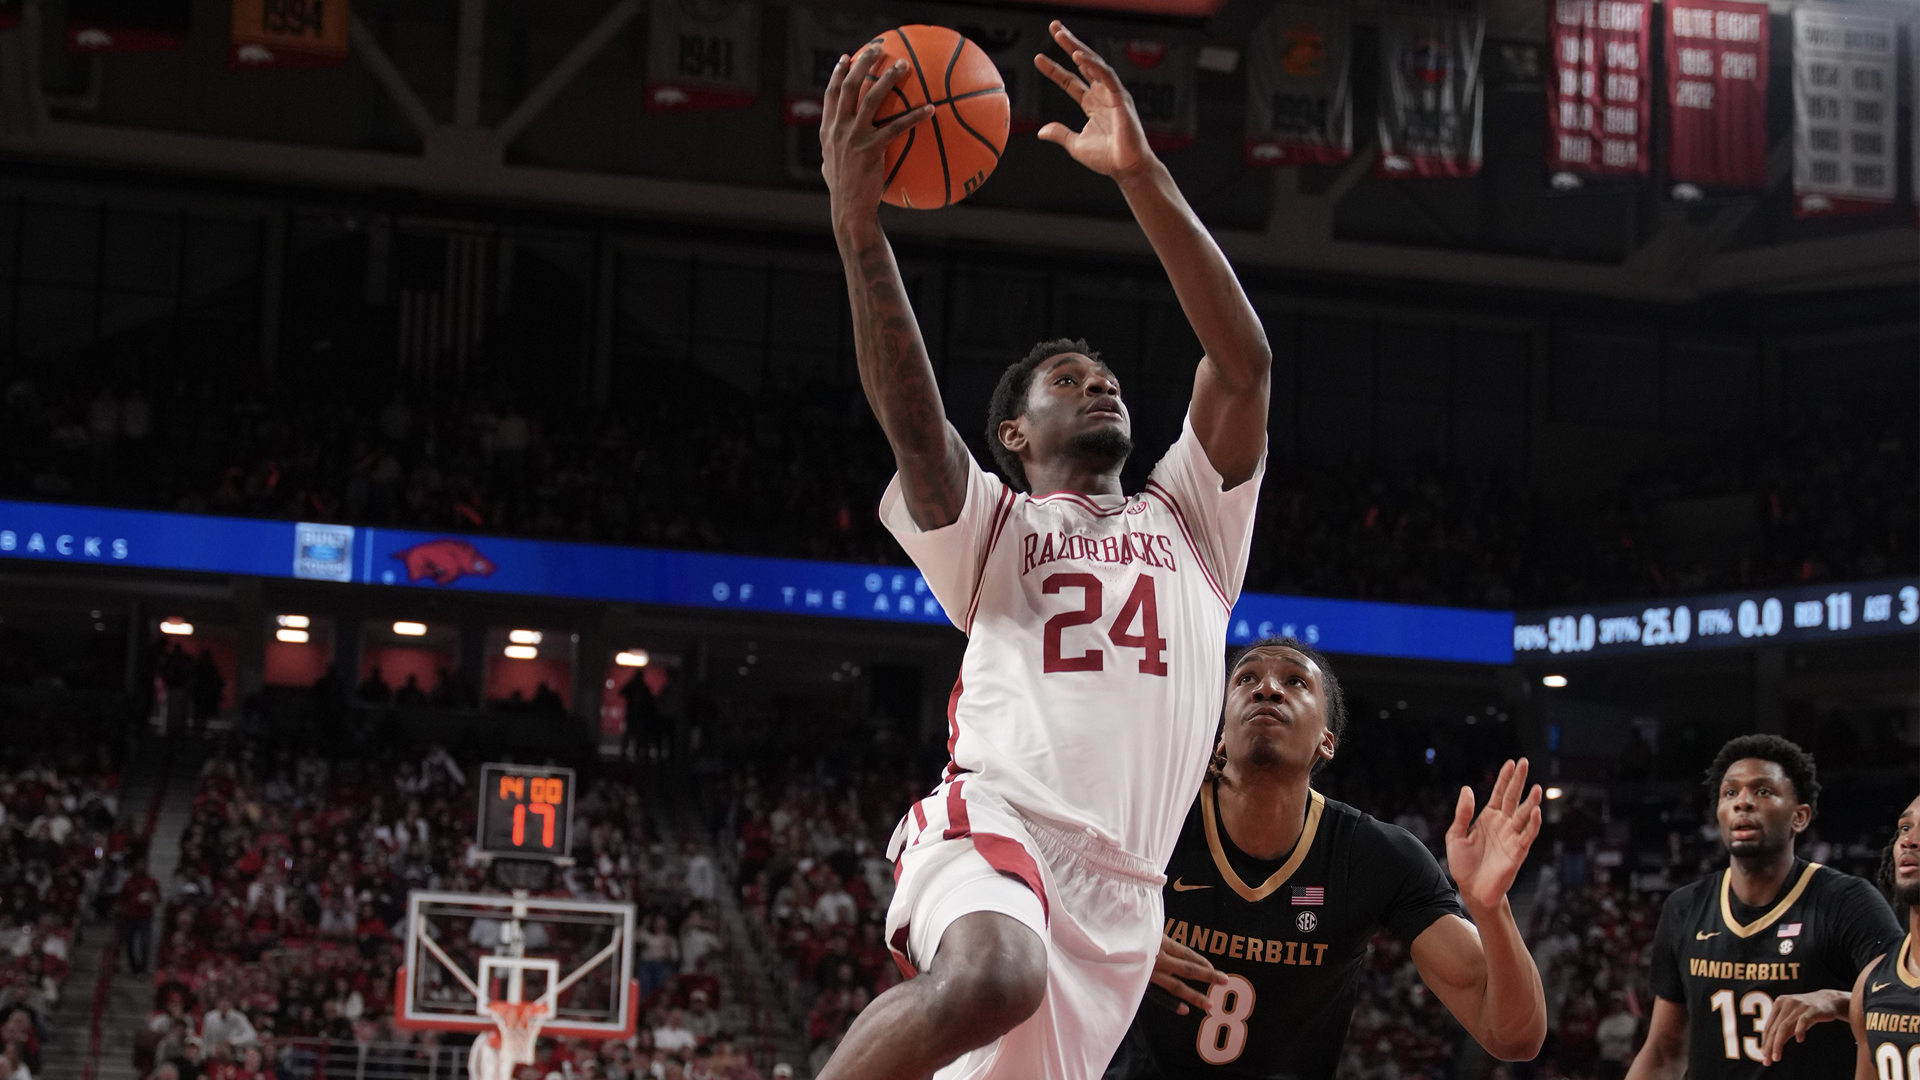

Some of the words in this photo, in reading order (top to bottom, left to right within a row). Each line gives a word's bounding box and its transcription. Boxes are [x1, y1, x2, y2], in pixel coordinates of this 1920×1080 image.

[1673, 7, 1715, 39] ELITE
[1716, 11, 1761, 43] EIGHT
[679, 34, 732, 78] 1941
[0, 530, 129, 560] BACKS
[1023, 531, 1177, 576] RAZORBACKS
[712, 582, 755, 603] OF
[781, 586, 847, 610] THE
[873, 594, 940, 617] ARK
[1548, 614, 1596, 654] 50.0
[1642, 605, 1692, 647] 25.0
[1738, 597, 1784, 638] 0.0
[1825, 592, 1852, 631] 11
[1898, 585, 1920, 625] 3
[1042, 573, 1168, 677] 24
[512, 803, 556, 848] 17
[1298, 913, 1316, 931] SEC
[1690, 957, 1801, 981] VANDERBILT
[1196, 972, 1256, 1066] 8
[1710, 988, 1774, 1063] 13
